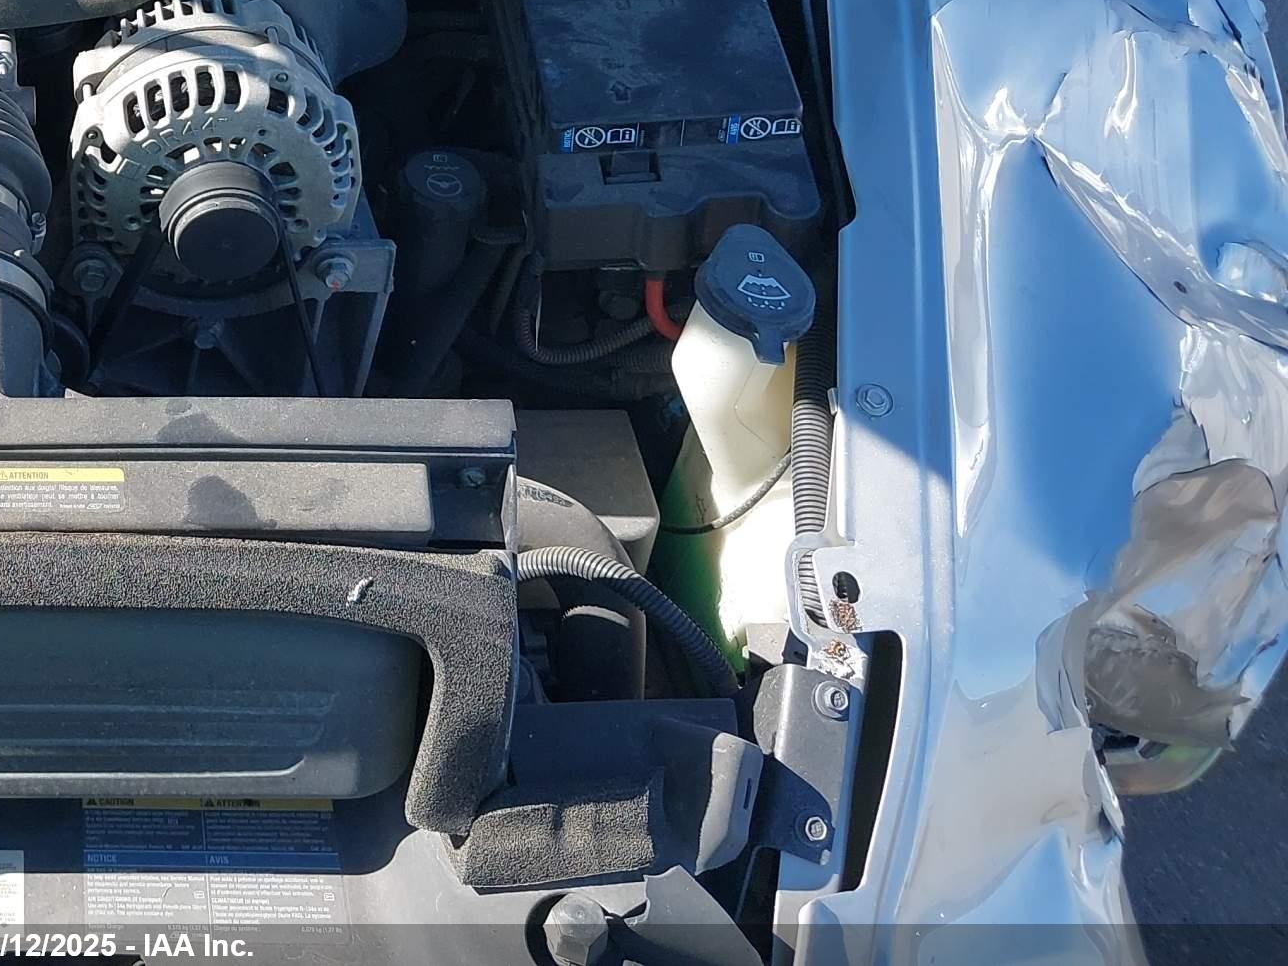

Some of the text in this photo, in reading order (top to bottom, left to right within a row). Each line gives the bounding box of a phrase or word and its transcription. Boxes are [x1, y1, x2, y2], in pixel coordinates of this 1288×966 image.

[9, 471, 49, 480] ATTENTION
[99, 797, 135, 806] CAUTION
[216, 799, 261, 808] ATTENTION
[87, 853, 118, 863] NOTICE
[209, 855, 230, 865] AVIS
